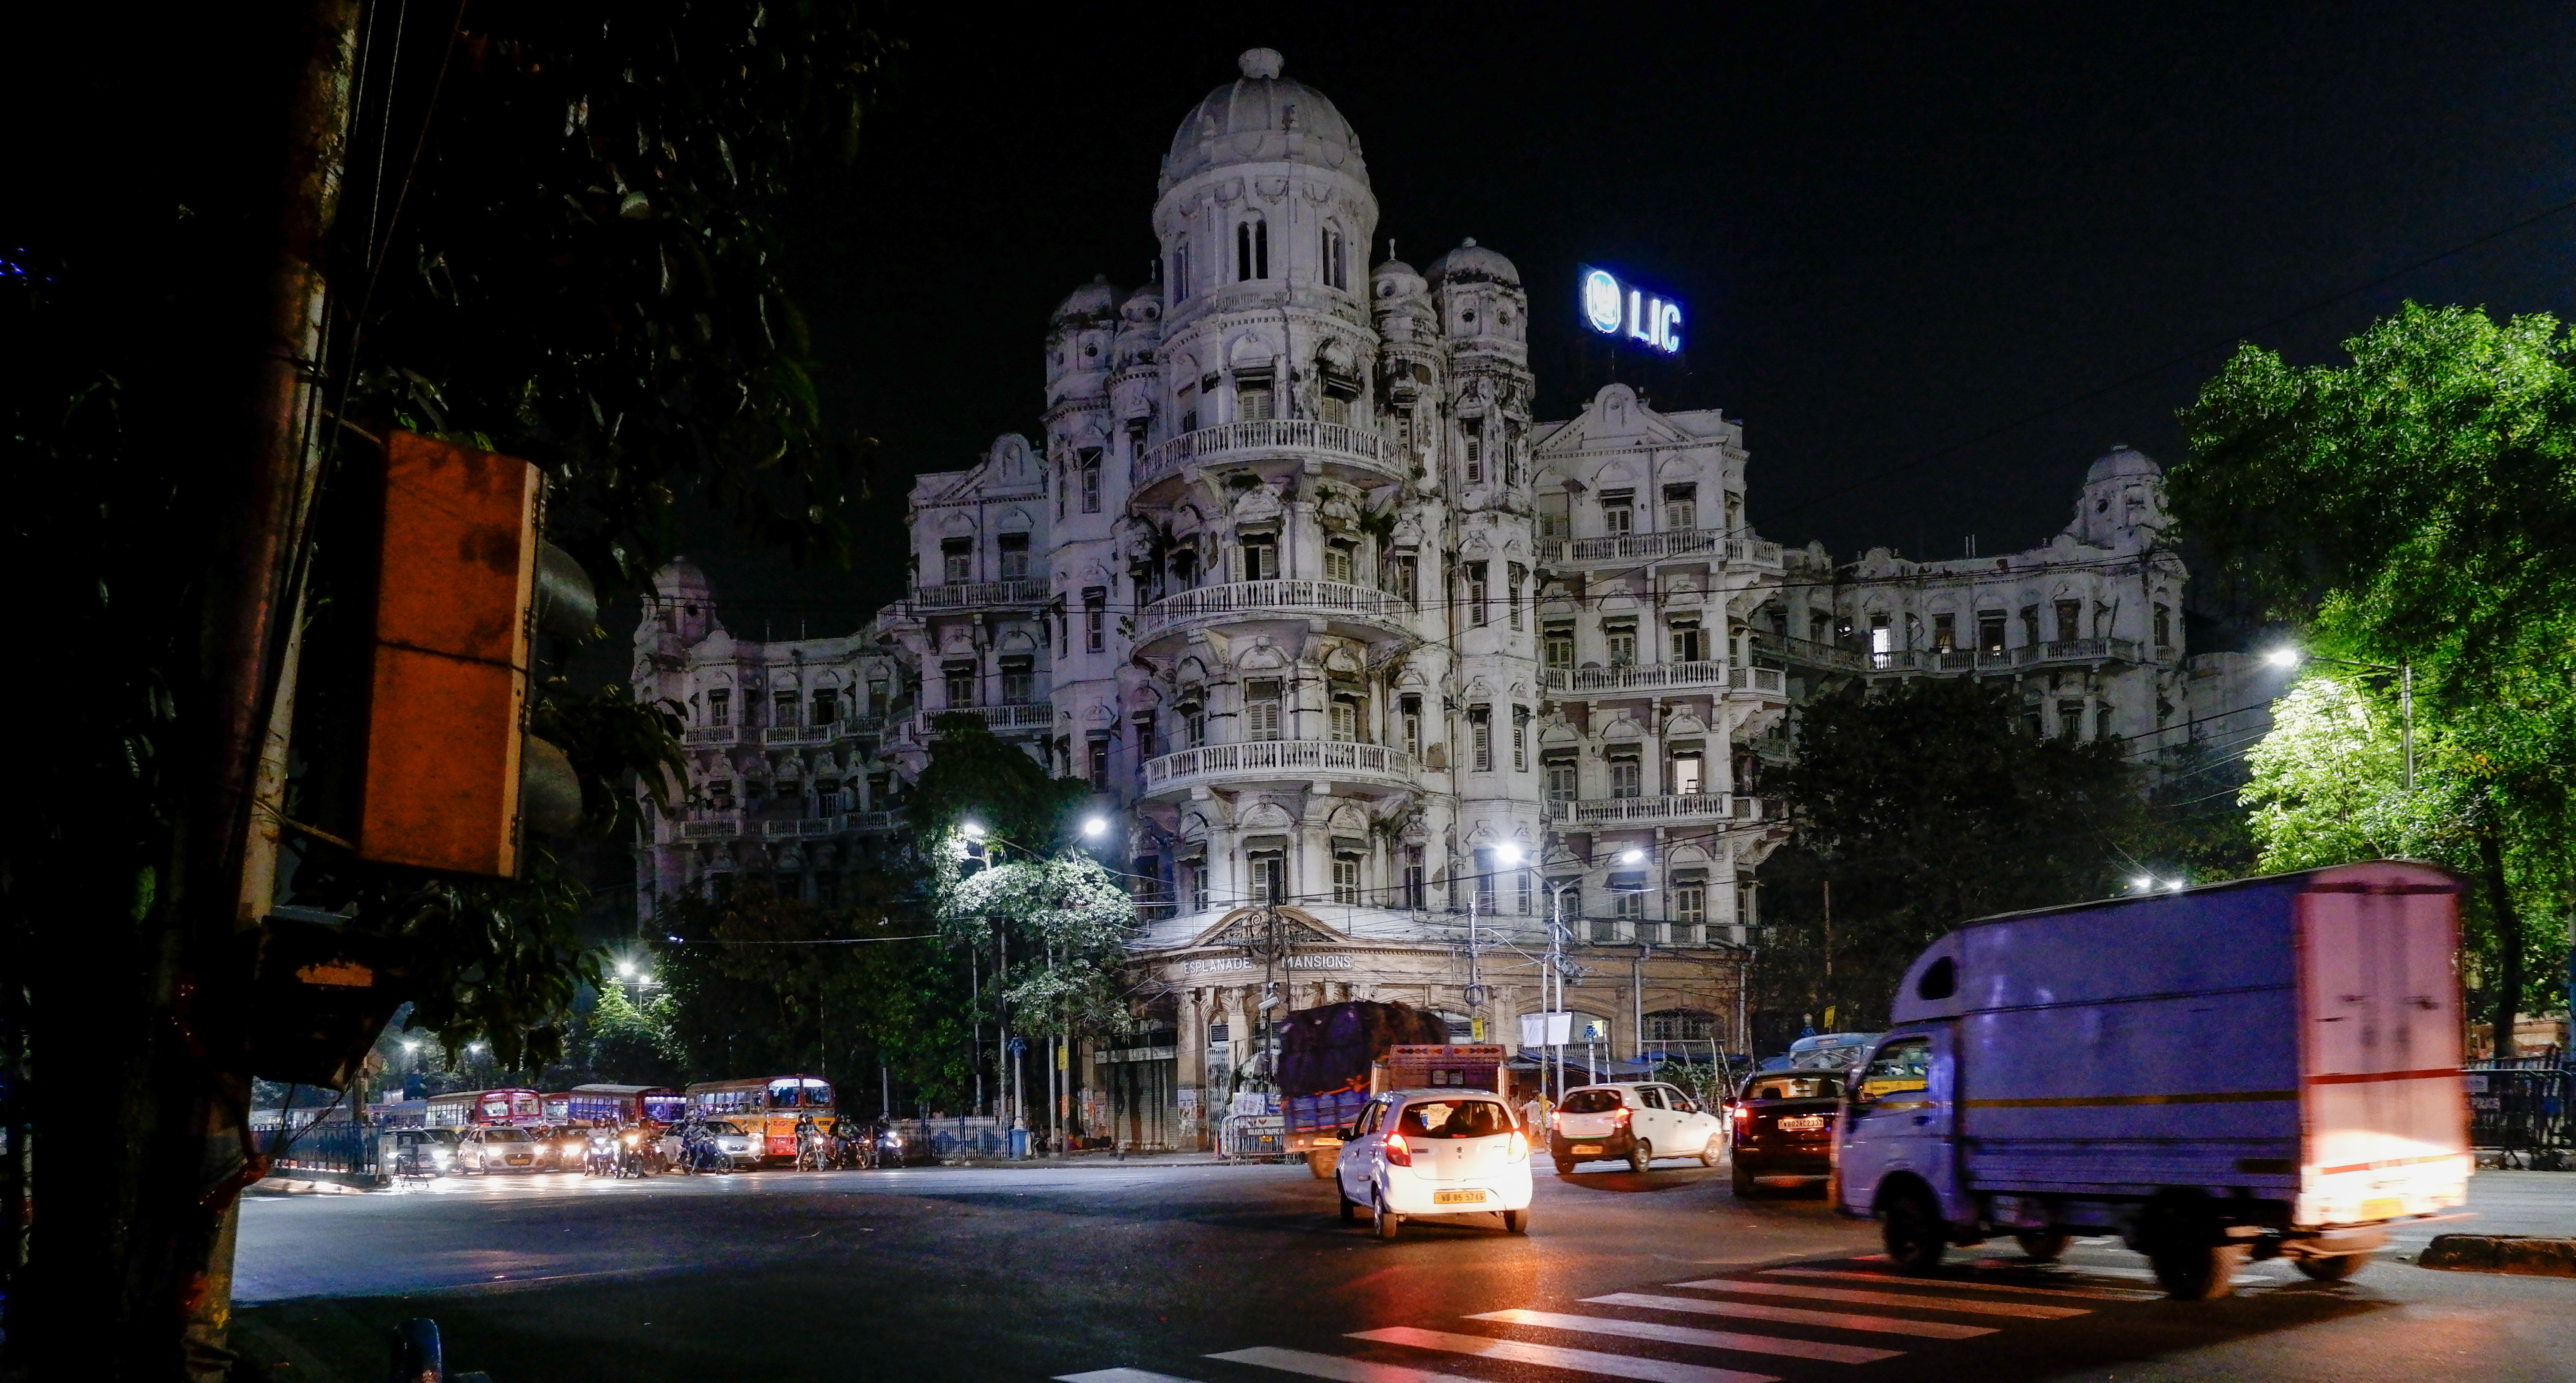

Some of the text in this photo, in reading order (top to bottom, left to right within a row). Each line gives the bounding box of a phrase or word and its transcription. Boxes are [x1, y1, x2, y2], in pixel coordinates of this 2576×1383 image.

[1631, 291, 1681, 353] LIC
[1184, 956, 1351, 975] ESPLANADE MANSIONS
